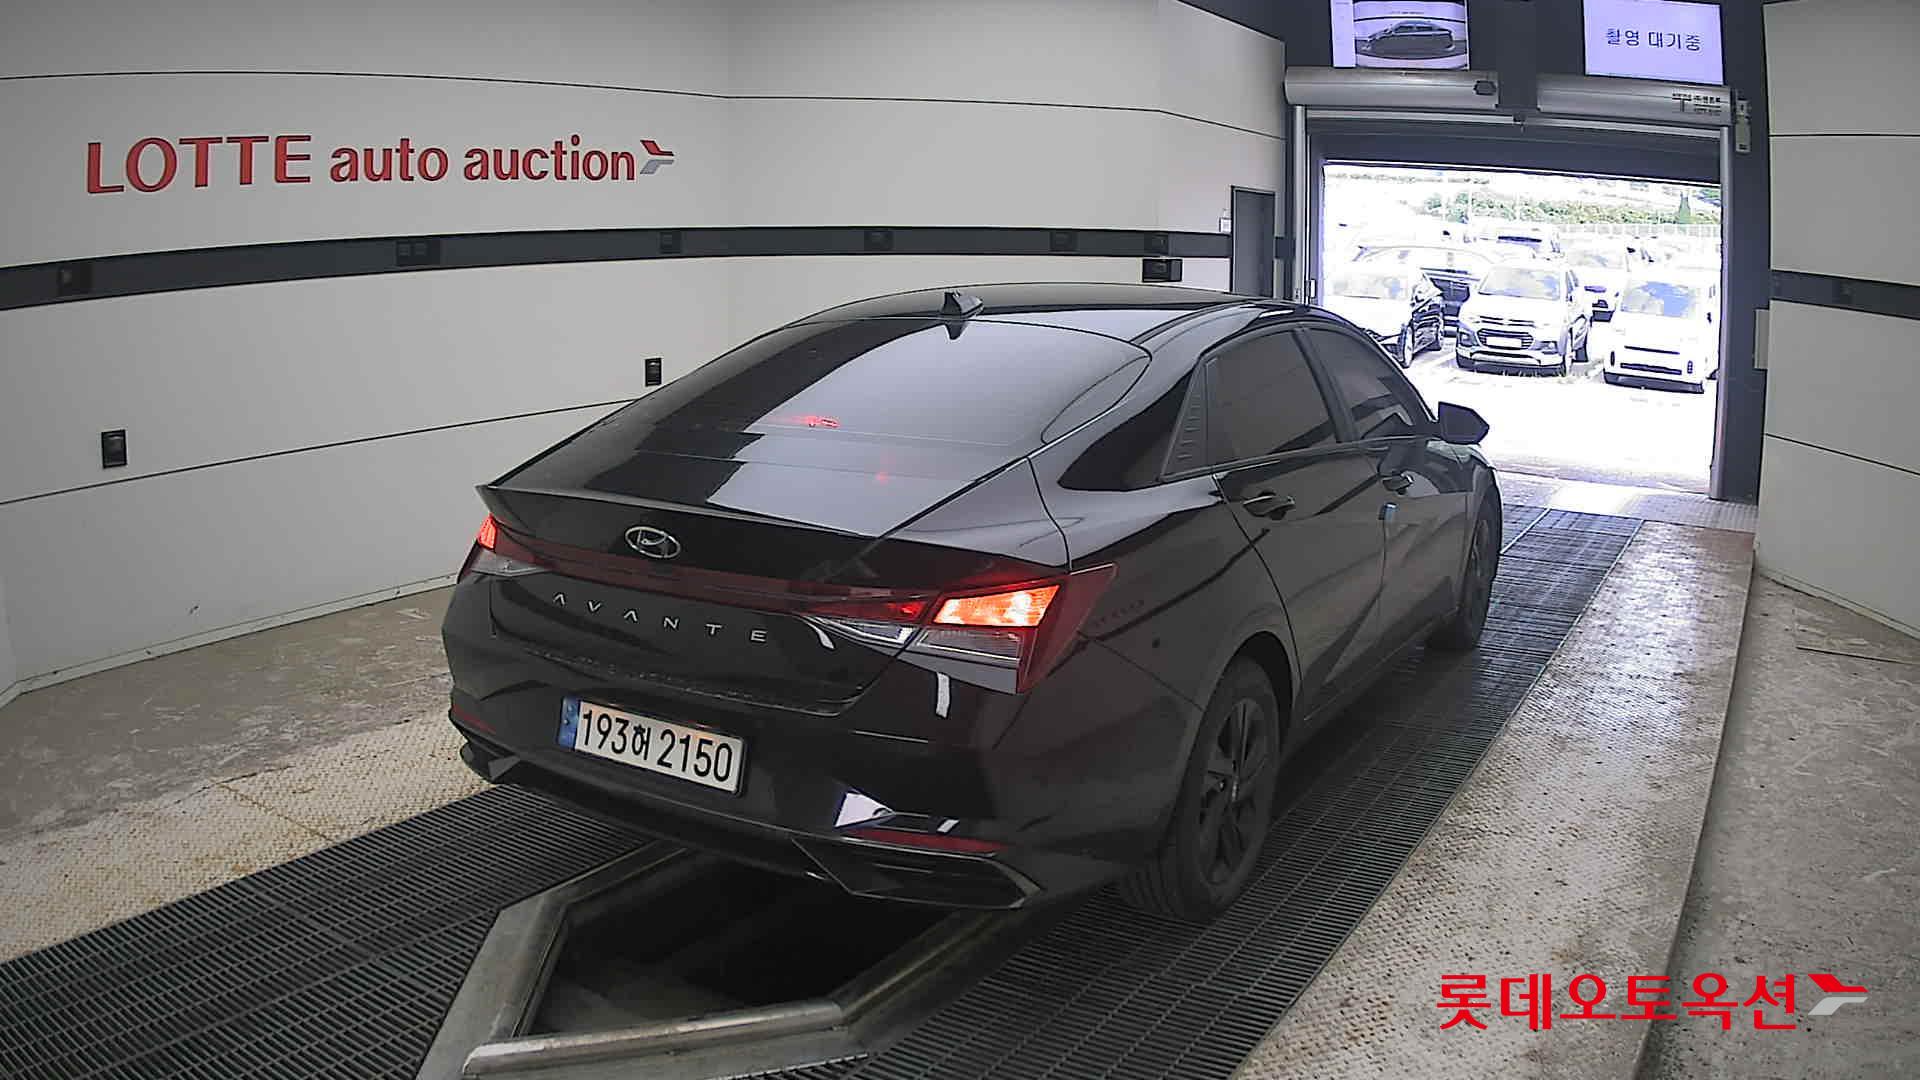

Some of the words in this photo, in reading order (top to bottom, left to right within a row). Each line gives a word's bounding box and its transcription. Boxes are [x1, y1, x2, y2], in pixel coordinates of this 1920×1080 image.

[1606, 27, 1640, 47] 촬영
[1647, 30, 1701, 52] 대기중
[86, 134, 312, 194] LOTTE
[329, 137, 449, 183] auto
[463, 133, 636, 182] auction
[552, 592, 768, 643] AVANTE
[582, 709, 652, 761] 193허
[656, 728, 733, 782] 2150
